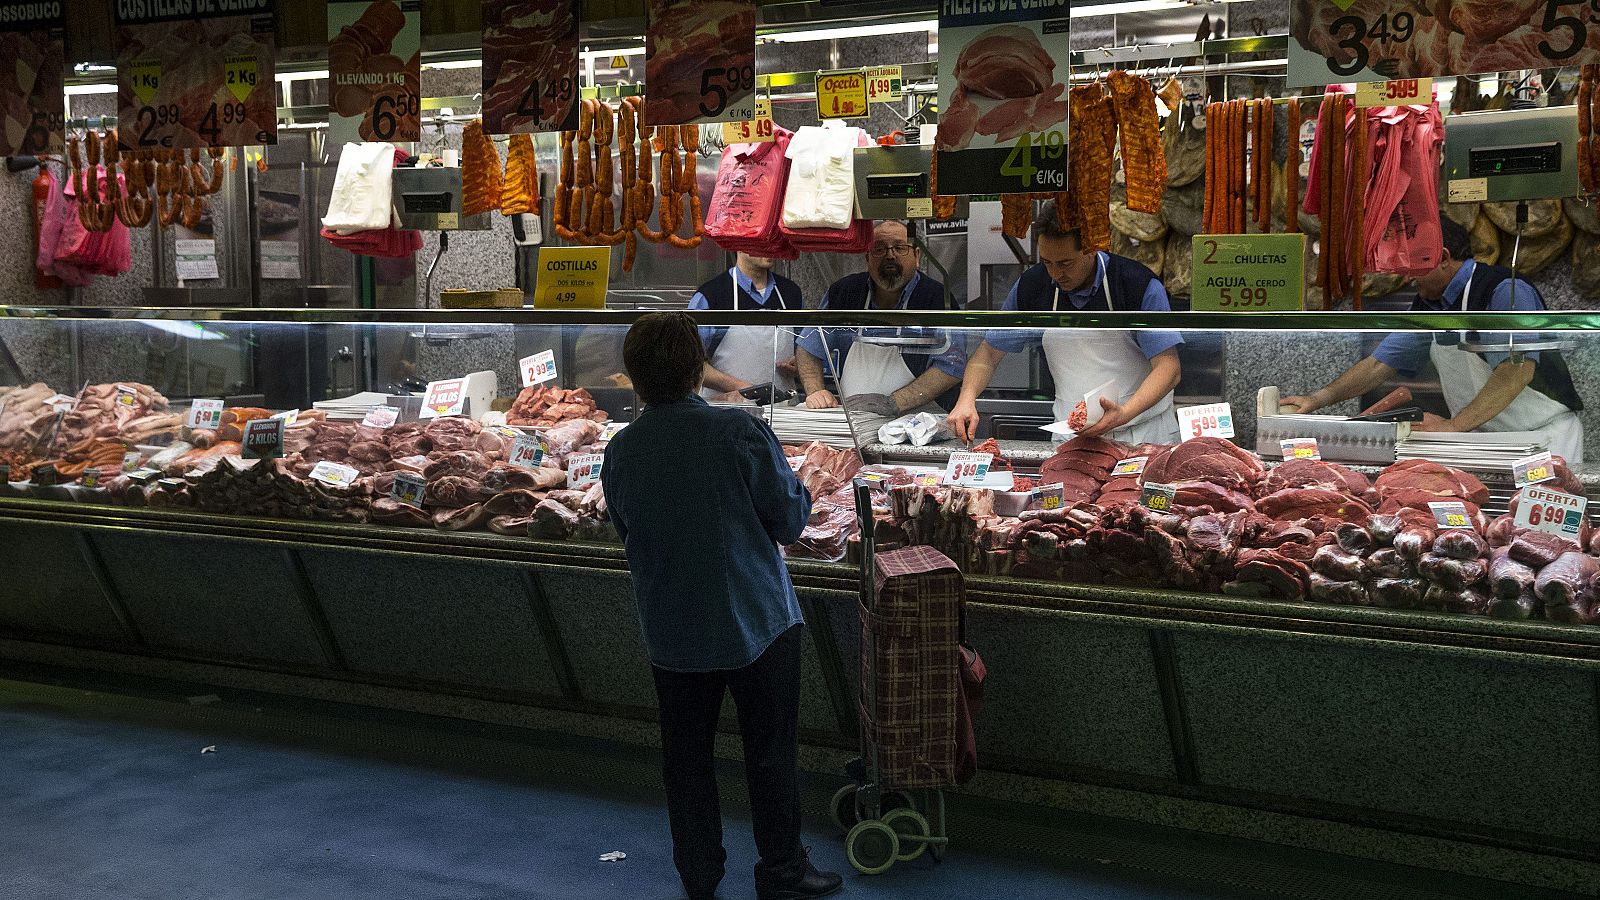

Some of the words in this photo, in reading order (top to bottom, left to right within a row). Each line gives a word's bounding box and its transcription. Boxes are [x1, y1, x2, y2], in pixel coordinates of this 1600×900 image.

[143, 75, 158, 88] Kg
[228, 71, 234, 83] 2
[240, 70, 255, 86] Kg
[336, 73, 383, 85] LLEVANDO
[386, 74, 391, 83] 1
[394, 72, 405, 86] Kg
[824, 76, 861, 93] Oferta
[1036, 170, 1064, 188] €/Kg
[1203, 240, 1218, 265] 2
[1234, 255, 1287, 264] CHULETAS
[547, 260, 598, 272] COSTILLAS
[1206, 277, 1247, 288] AGUJA
[1255, 280, 1286, 288] CERDO
[430, 394, 437, 405] 2
[437, 391, 459, 403] KILOS
[1184, 406, 1223, 417] OFERTA
[248, 434, 255, 446] 2
[256, 432, 278, 445] KILOS
[571, 456, 602, 465] OFERTA
[1148, 495, 1167, 509] 499
[1529, 490, 1578, 507] OFERTA
